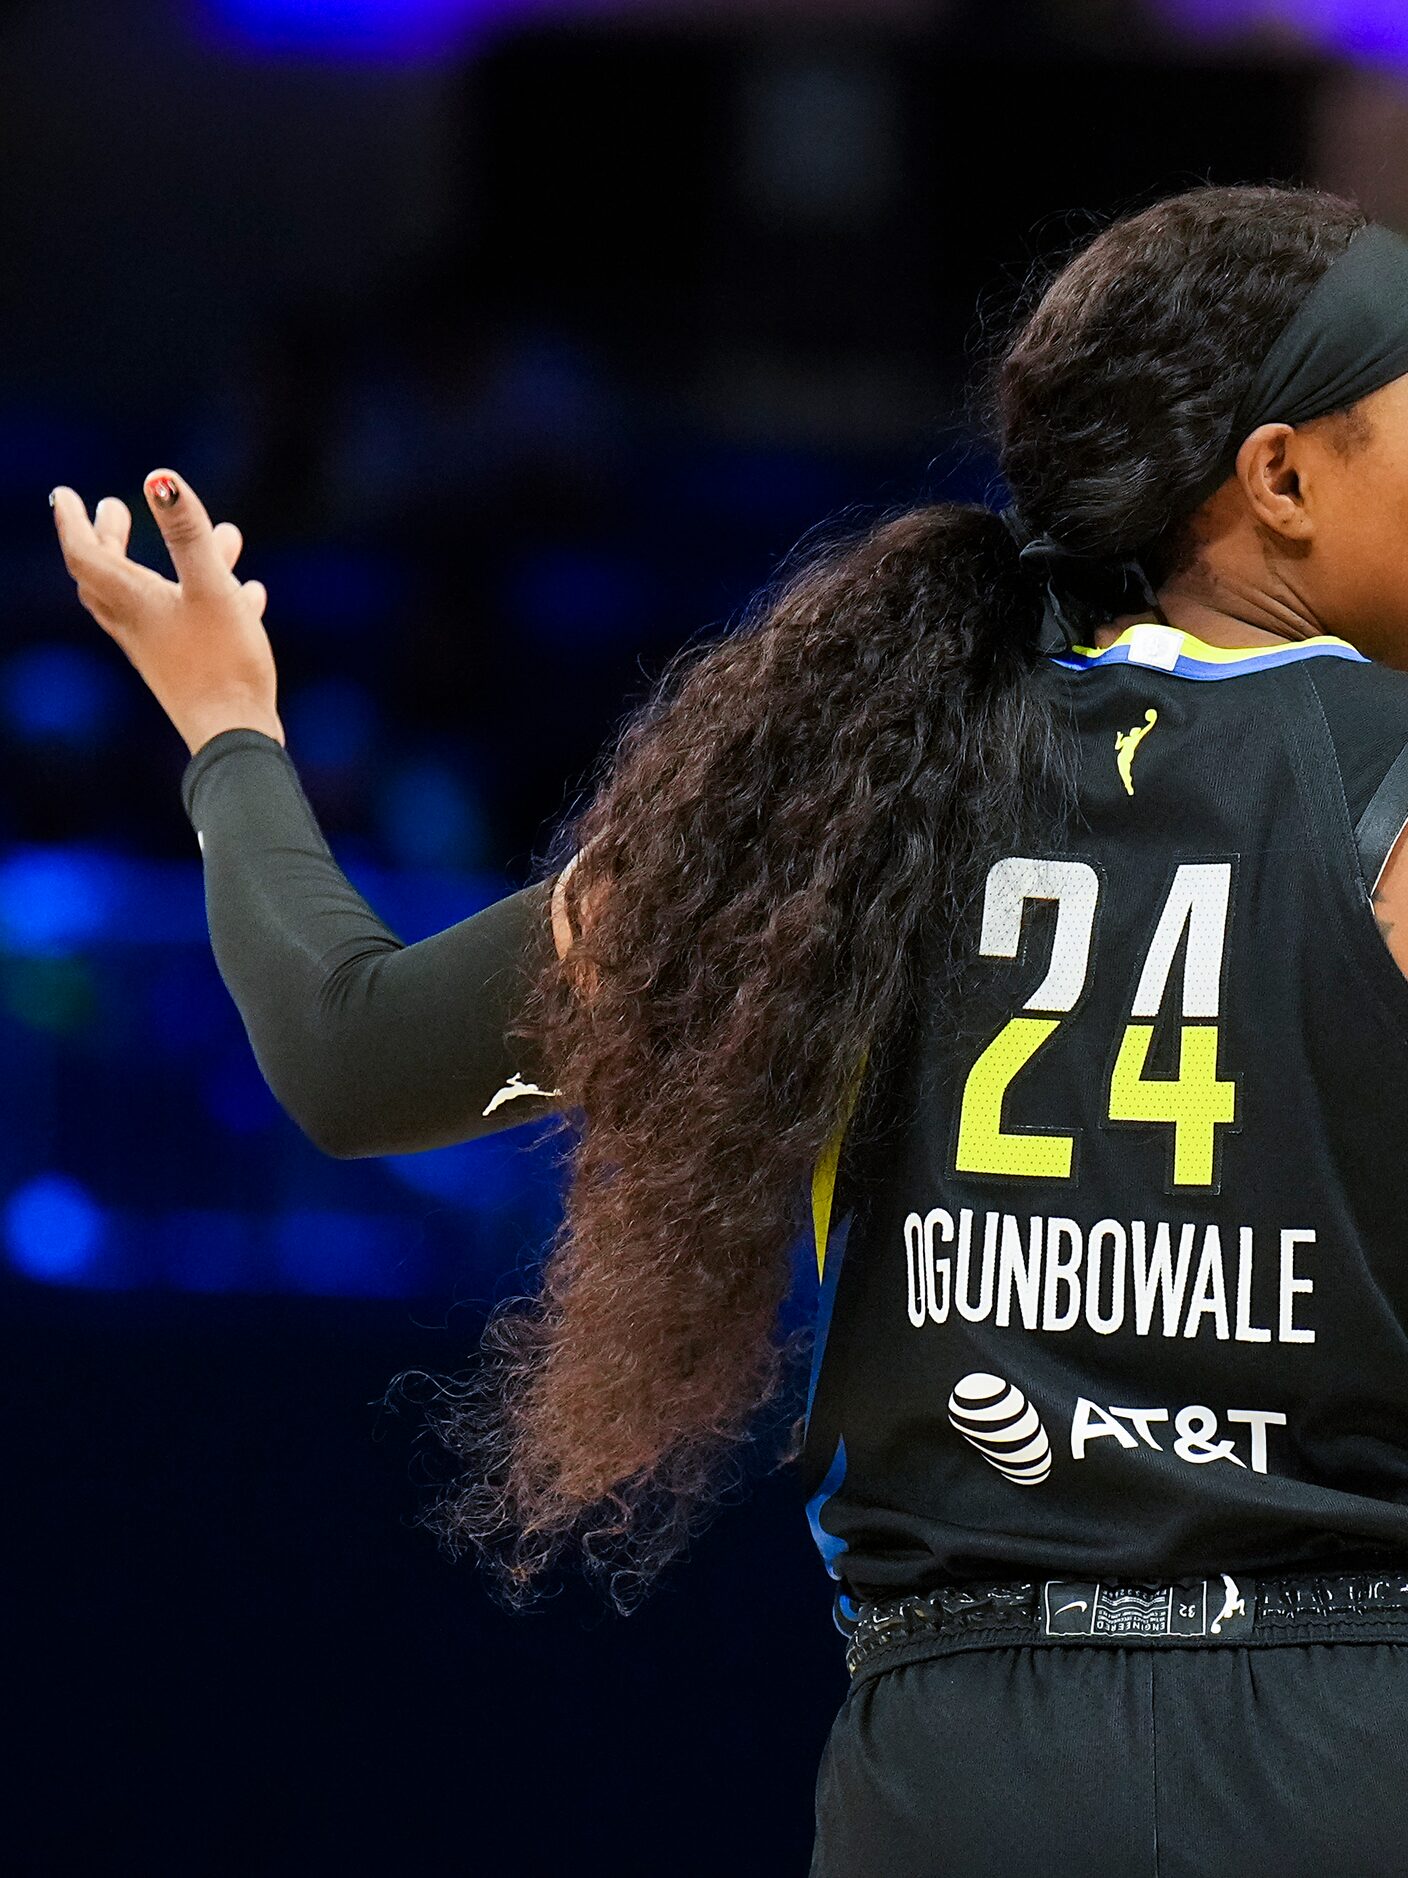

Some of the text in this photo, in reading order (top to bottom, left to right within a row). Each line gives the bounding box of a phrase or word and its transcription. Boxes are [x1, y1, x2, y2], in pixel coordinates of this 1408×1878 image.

[956, 856, 1236, 1186] 24
[903, 1207, 1317, 1344] OGUNBOWALE
[1070, 1396, 1288, 1475] AT&T
[1096, 1620, 1166, 1632] ENGINEERED
